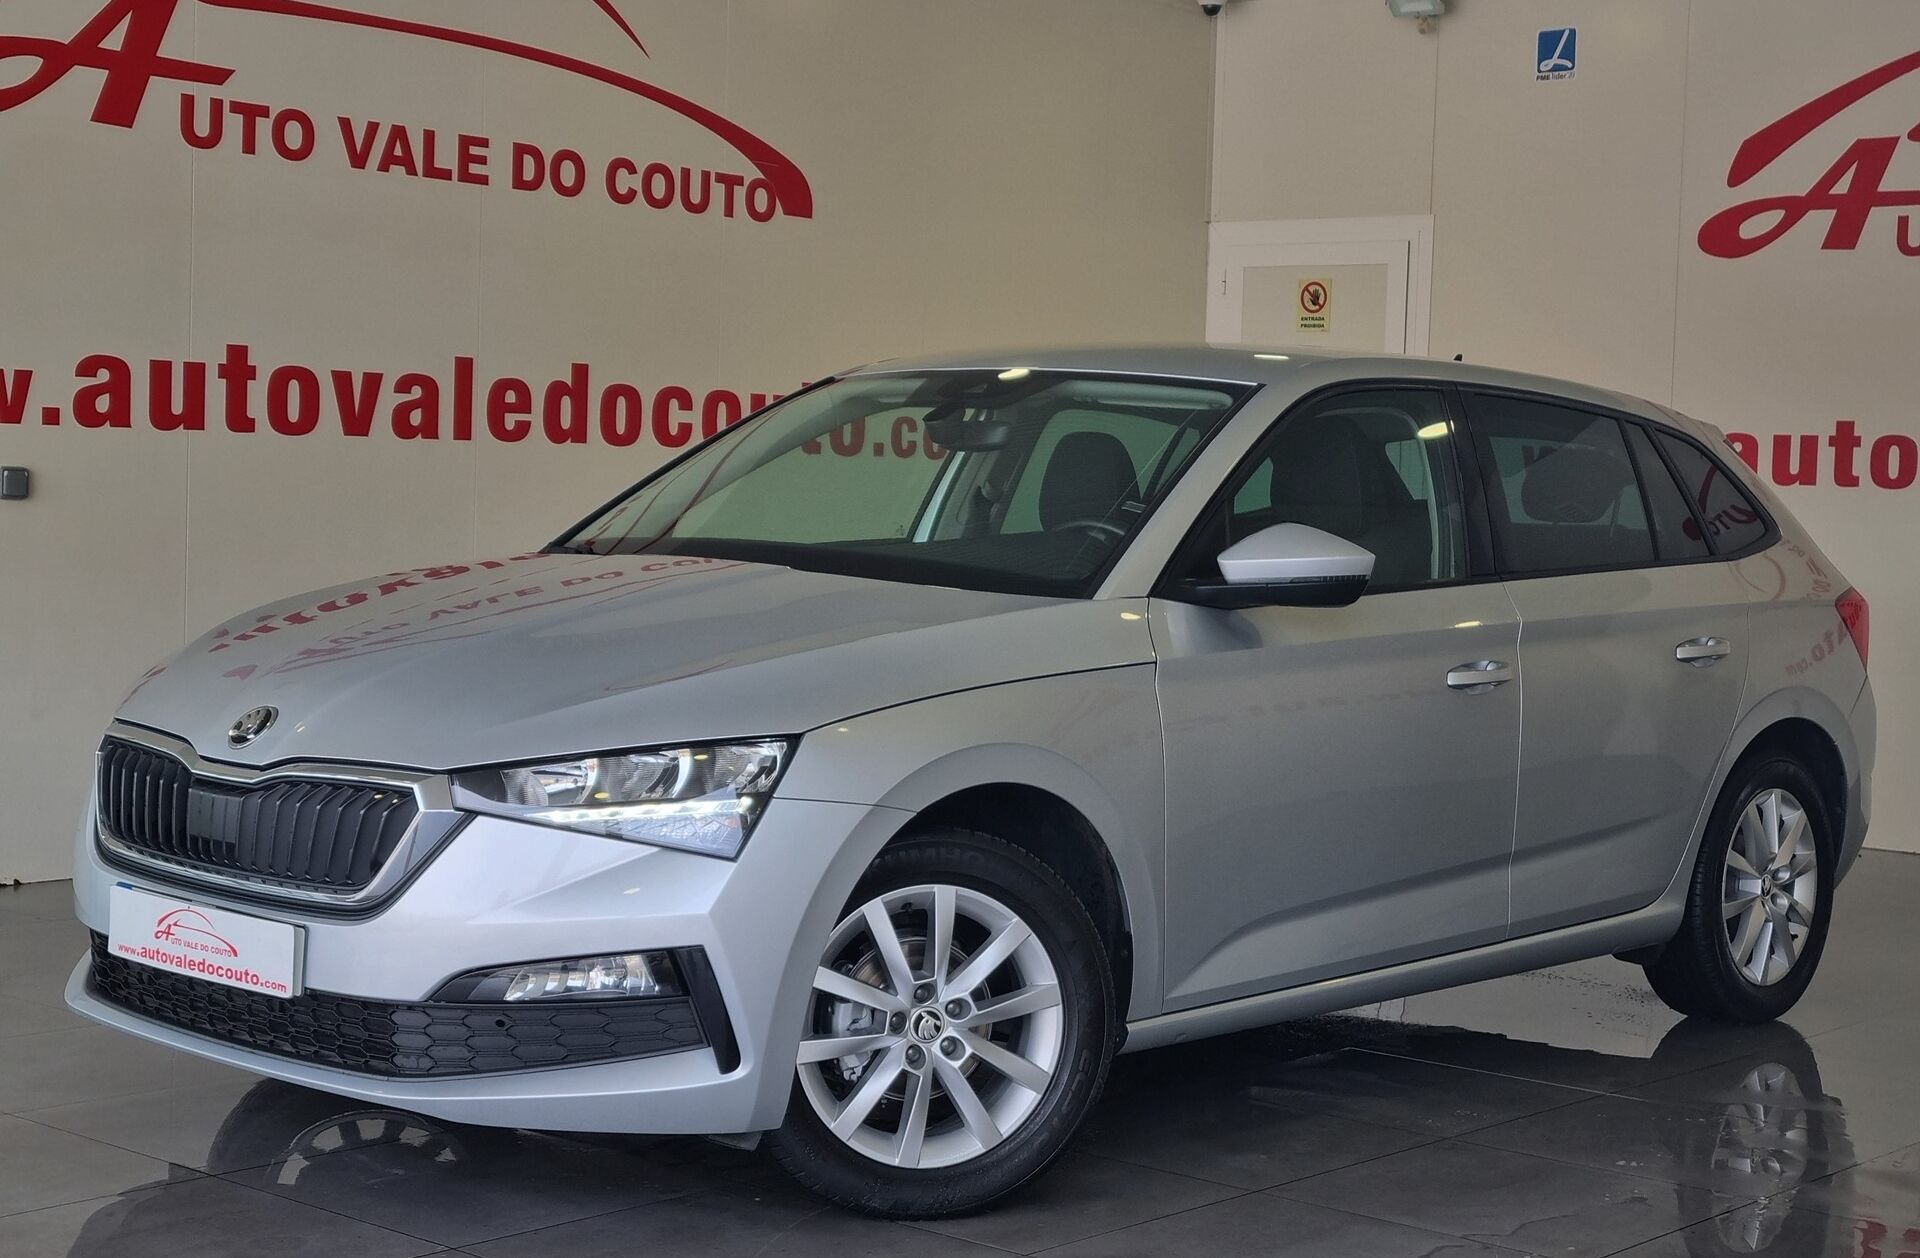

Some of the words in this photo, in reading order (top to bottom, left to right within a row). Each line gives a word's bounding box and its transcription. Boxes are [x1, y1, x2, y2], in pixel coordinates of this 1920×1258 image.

[337, 116, 490, 186] VALE
[511, 142, 586, 198] DO
[604, 157, 778, 223] COUTO
[117, 943, 287, 993] www.autovaledocouto.com
[183, 940, 199, 950] VALE
[200, 943, 209, 952] DO
[210, 946, 232, 958] COUTO
